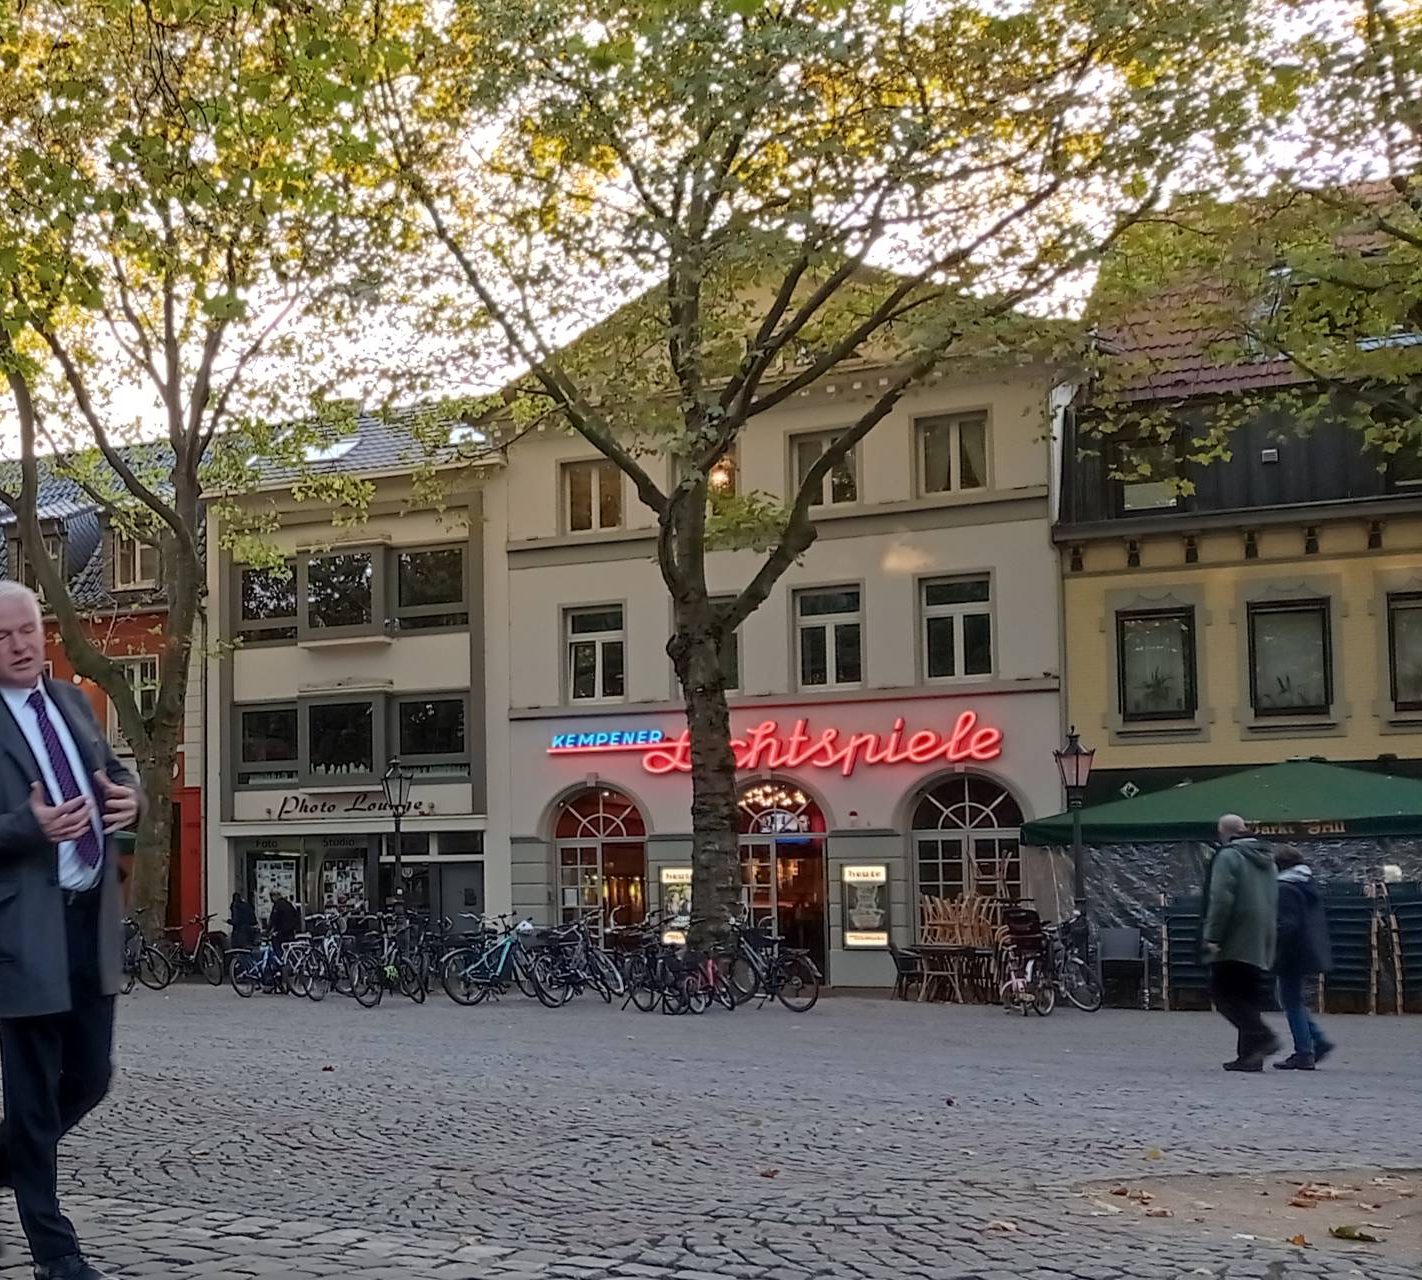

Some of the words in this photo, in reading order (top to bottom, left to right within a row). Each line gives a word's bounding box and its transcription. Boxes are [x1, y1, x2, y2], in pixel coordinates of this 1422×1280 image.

[552, 730, 663, 749] KEMPENER
[642, 710, 1002, 777] Lchtspiele
[277, 796, 336, 820] Photo
[256, 839, 278, 848] Foto
[322, 838, 355, 847] Studio
